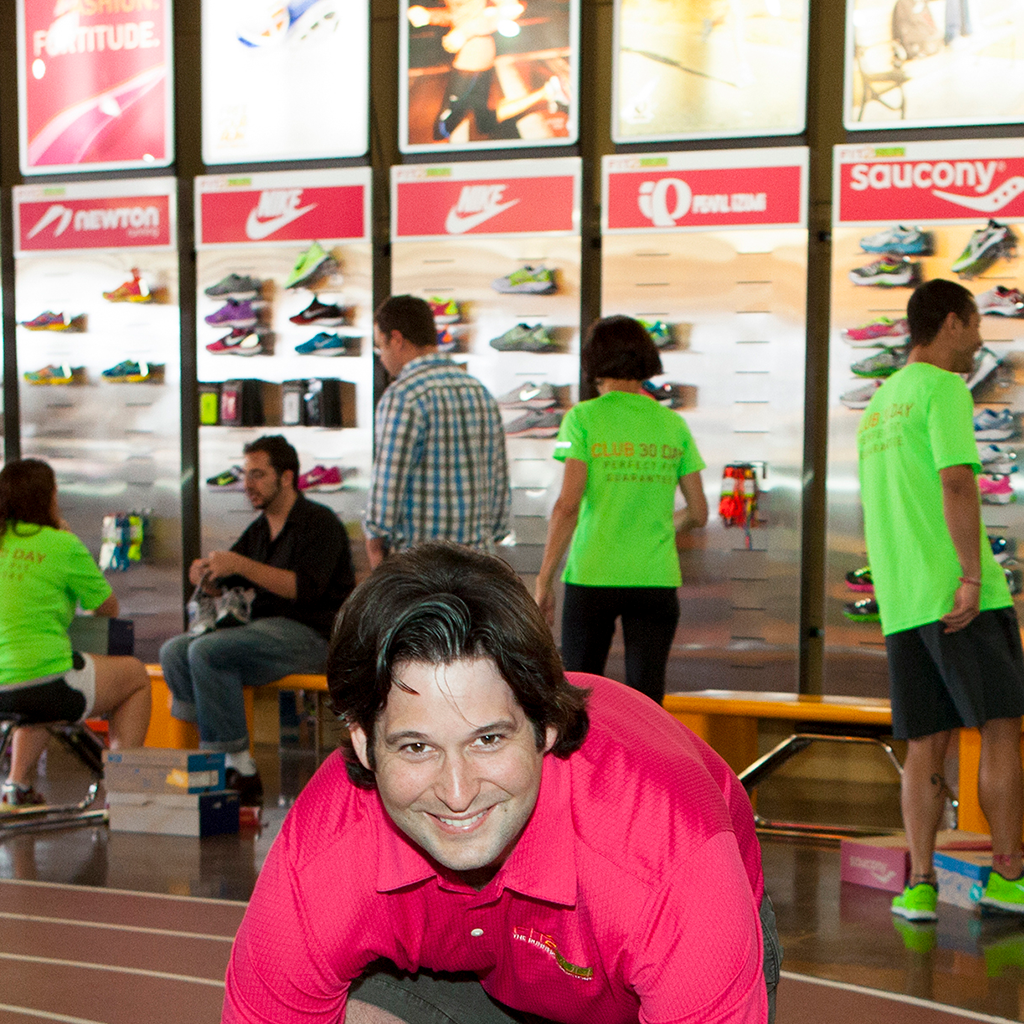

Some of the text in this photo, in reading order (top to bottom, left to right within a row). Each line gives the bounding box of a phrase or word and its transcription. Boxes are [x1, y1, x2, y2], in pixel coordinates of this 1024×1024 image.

[850, 161, 998, 193] saucony
[257, 189, 304, 217] NIKE
[457, 183, 508, 213] NIKE
[591, 441, 635, 458] CLUB
[639, 443, 657, 458] 30
[12, 548, 48, 565] DAY
